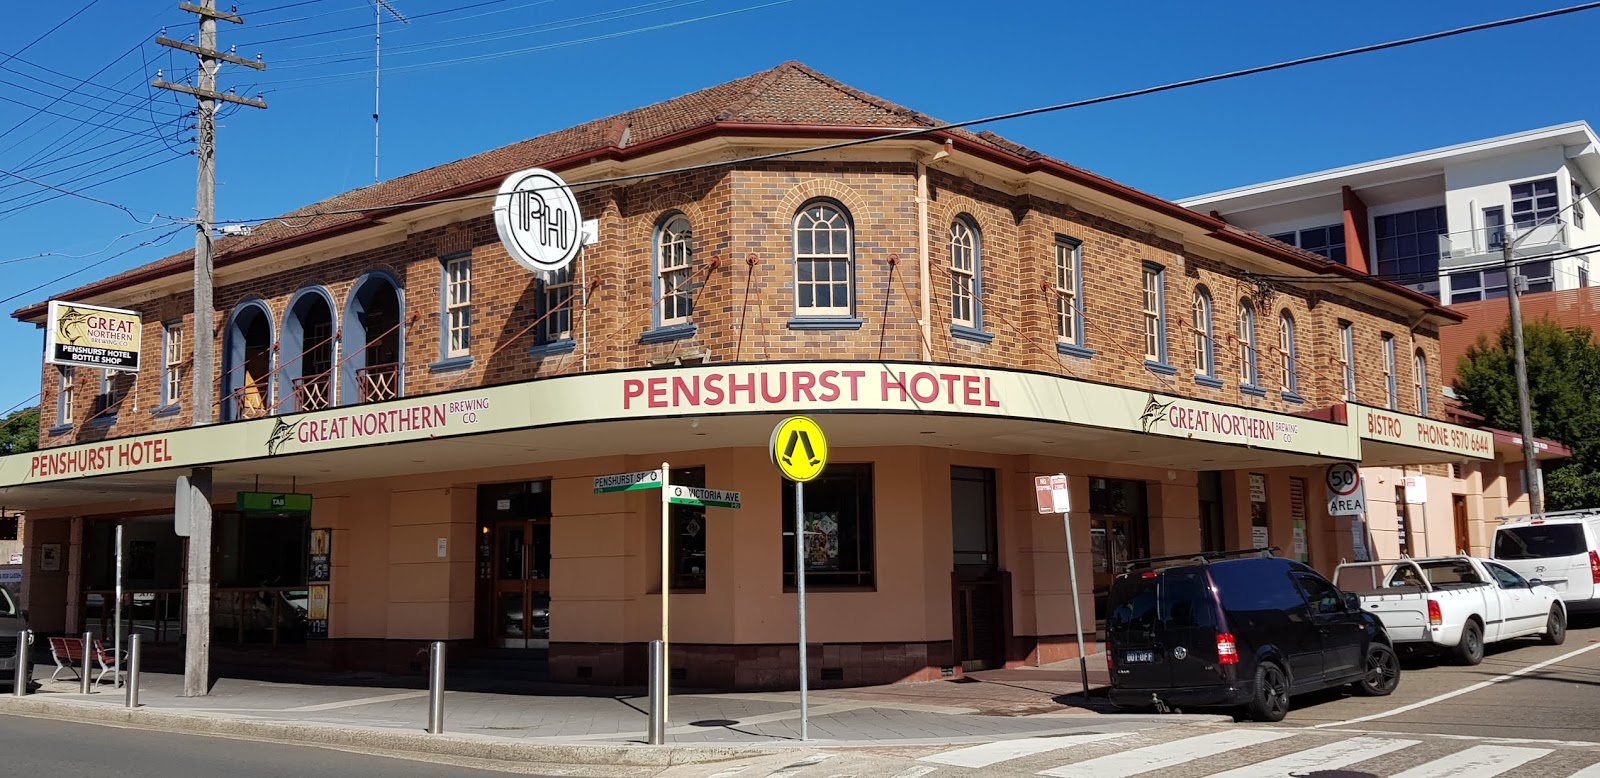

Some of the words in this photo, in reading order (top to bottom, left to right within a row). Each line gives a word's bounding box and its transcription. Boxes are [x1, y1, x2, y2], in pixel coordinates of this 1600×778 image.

[87, 316, 135, 333] GREAT
[87, 329, 133, 341] NORTHERN
[91, 338, 118, 346] BREWING
[62, 345, 106, 356] PENSHURST
[107, 349, 132, 359] HOTEL
[72, 353, 100, 363] BOTTLE
[101, 356, 122, 365] SHOP
[623, 370, 866, 410] PENSHURST
[881, 371, 1000, 408] HOTEL
[449, 397, 489, 413] BREWING
[297, 416, 348, 444] GREAT
[351, 403, 447, 438] NORTHERN
[462, 412, 479, 424] CO.
[1168, 405, 1210, 432] GREAT
[1212, 412, 1275, 441] NORTHERN
[1275, 421, 1298, 434] BREWING
[1367, 412, 1402, 438] BISTRO
[1417, 422, 1450, 447] PHONE
[1451, 429, 1469, 451] 9570
[1471, 433, 1489, 454] 6644
[31, 445, 114, 478] PENSHURST
[118, 438, 172, 467] HOTEL
[595, 473, 634, 488] PENSHURST
[636, 472, 645, 483] ST
[1332, 470, 1353, 486] 50
[272, 498, 285, 506] TAB
[688, 488, 722, 500] VICTORIA
[725, 492, 740, 502] AVE
[1330, 500, 1363, 511] AREA
